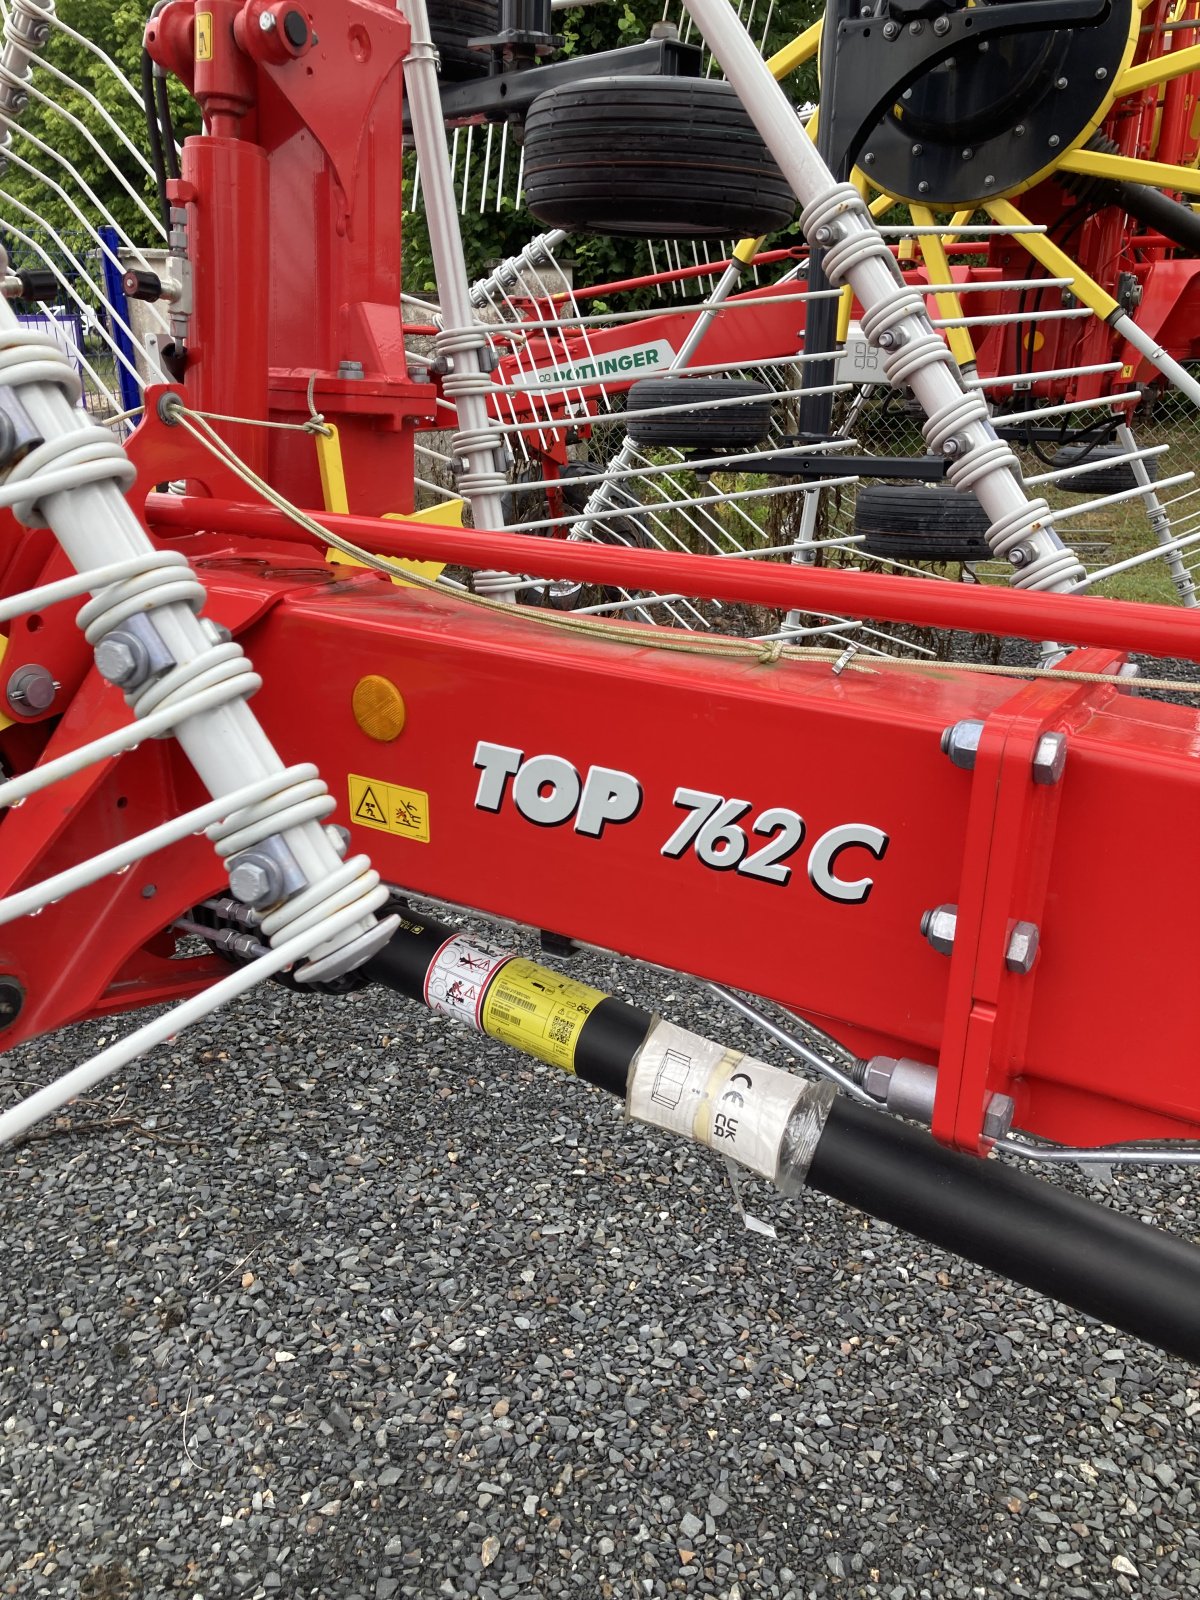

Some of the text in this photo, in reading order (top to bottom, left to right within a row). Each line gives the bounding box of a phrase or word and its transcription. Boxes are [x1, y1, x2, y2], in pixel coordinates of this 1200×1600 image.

[473, 740, 643, 839] TOP
[722, 1073, 752, 1108] CE
[724, 1118, 739, 1143] UK
